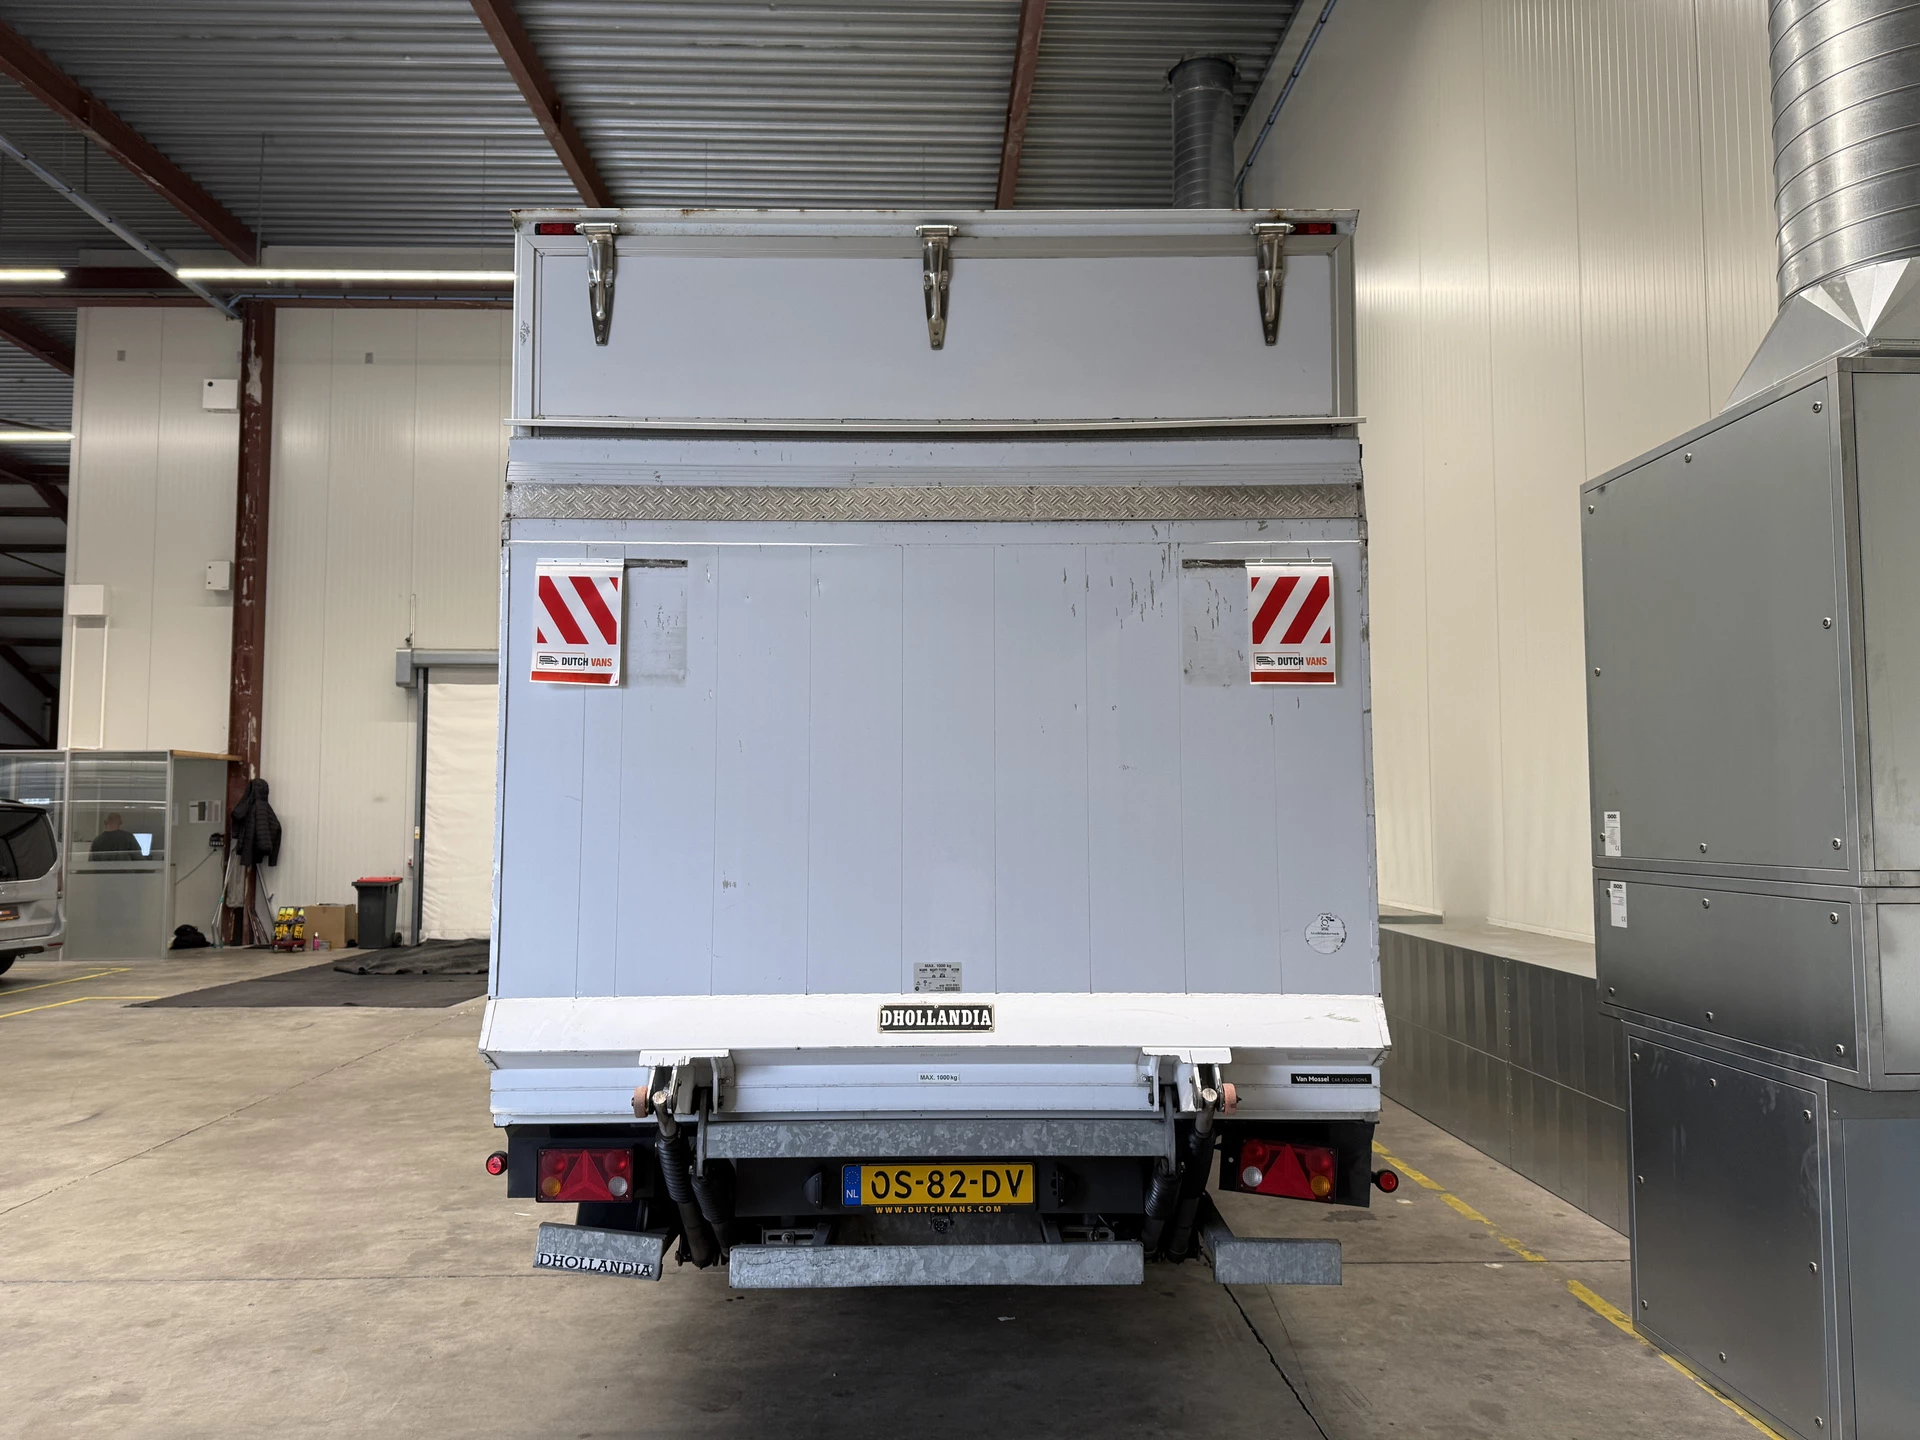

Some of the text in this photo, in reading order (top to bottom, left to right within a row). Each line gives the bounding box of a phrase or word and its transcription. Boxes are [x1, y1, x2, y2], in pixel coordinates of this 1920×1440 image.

[561, 656, 613, 667] DUTCH VANS
[1277, 656, 1328, 666] DUTCH VANS
[880, 1009, 992, 1026] DHOLLANDIA
[870, 1169, 1024, 1199] OS-82-DV
[845, 1189, 859, 1199] NL
[875, 1205, 1002, 1214] WWW.DUTCHVANS.COM
[538, 1252, 653, 1277] DHOLLANDIA
